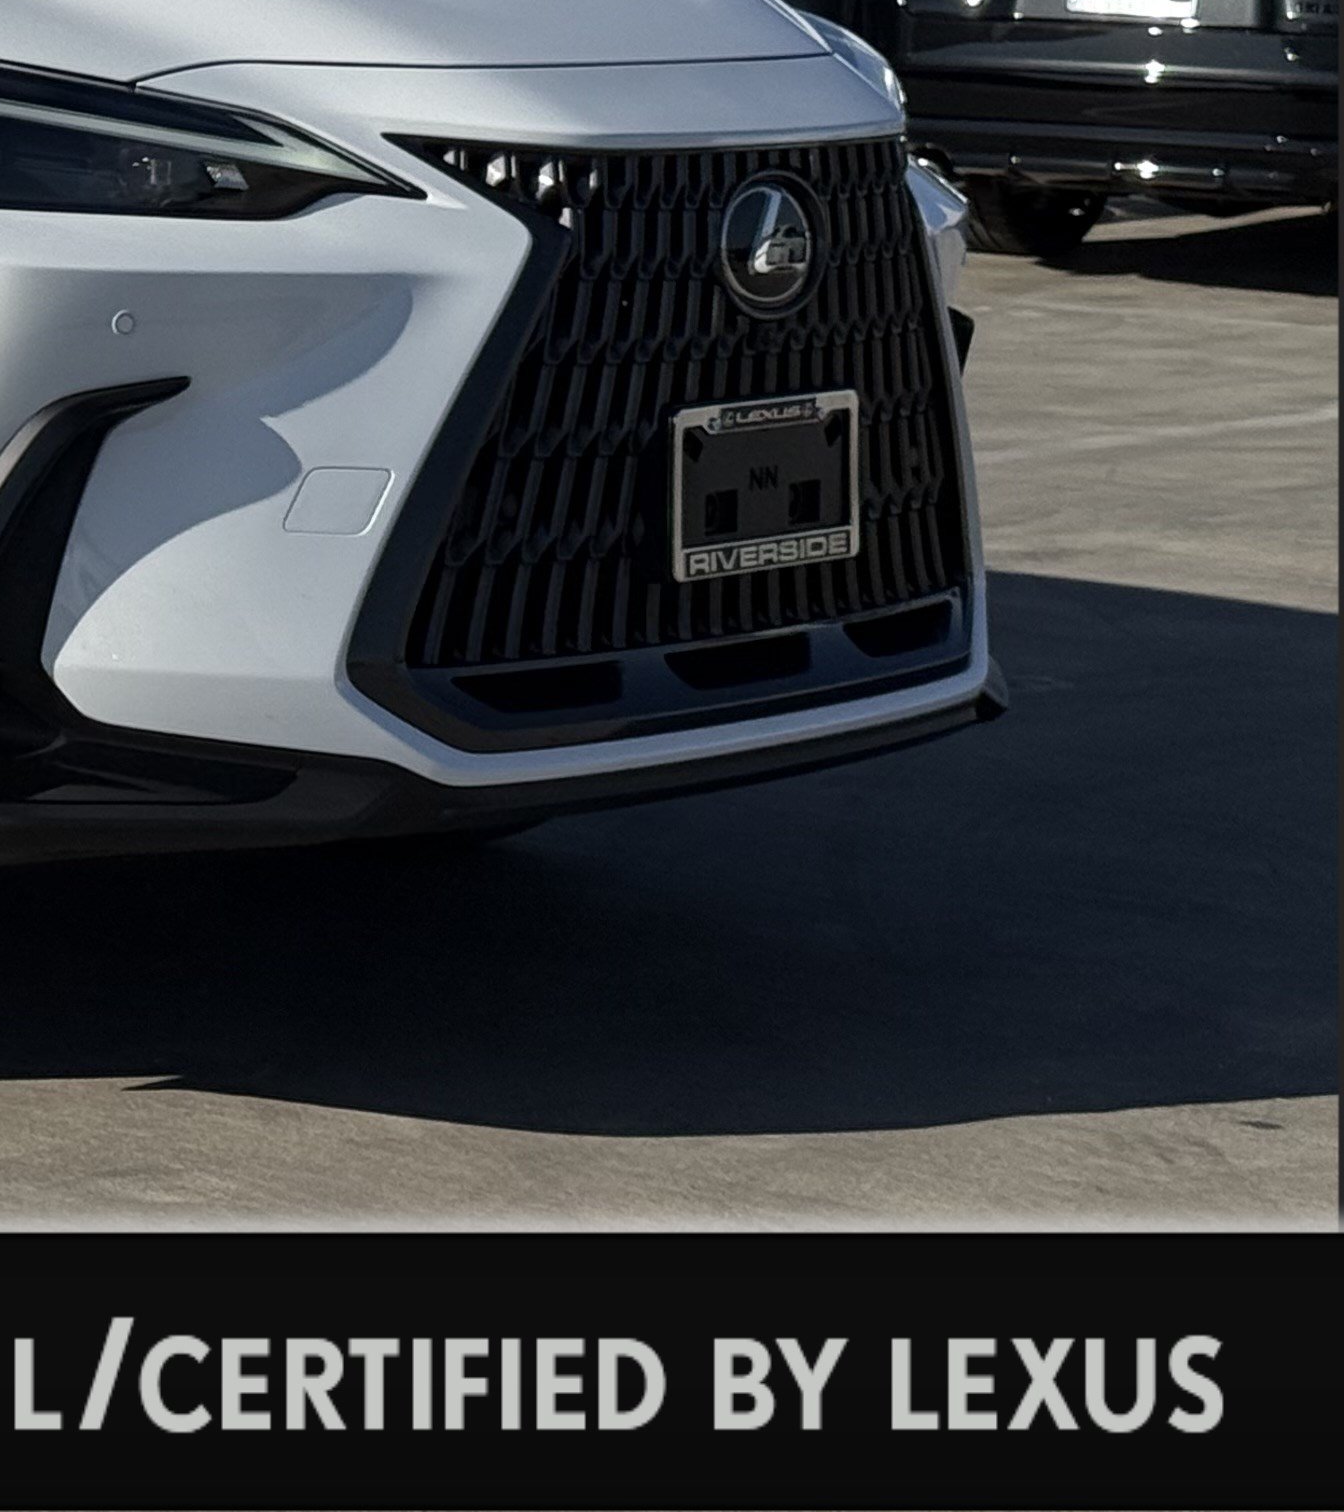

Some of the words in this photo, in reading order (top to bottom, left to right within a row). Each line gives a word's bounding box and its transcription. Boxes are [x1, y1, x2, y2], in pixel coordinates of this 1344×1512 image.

[736, 404, 802, 424] LEXUS
[749, 464, 779, 491] NN
[689, 532, 849, 576] RIVERSIDE
